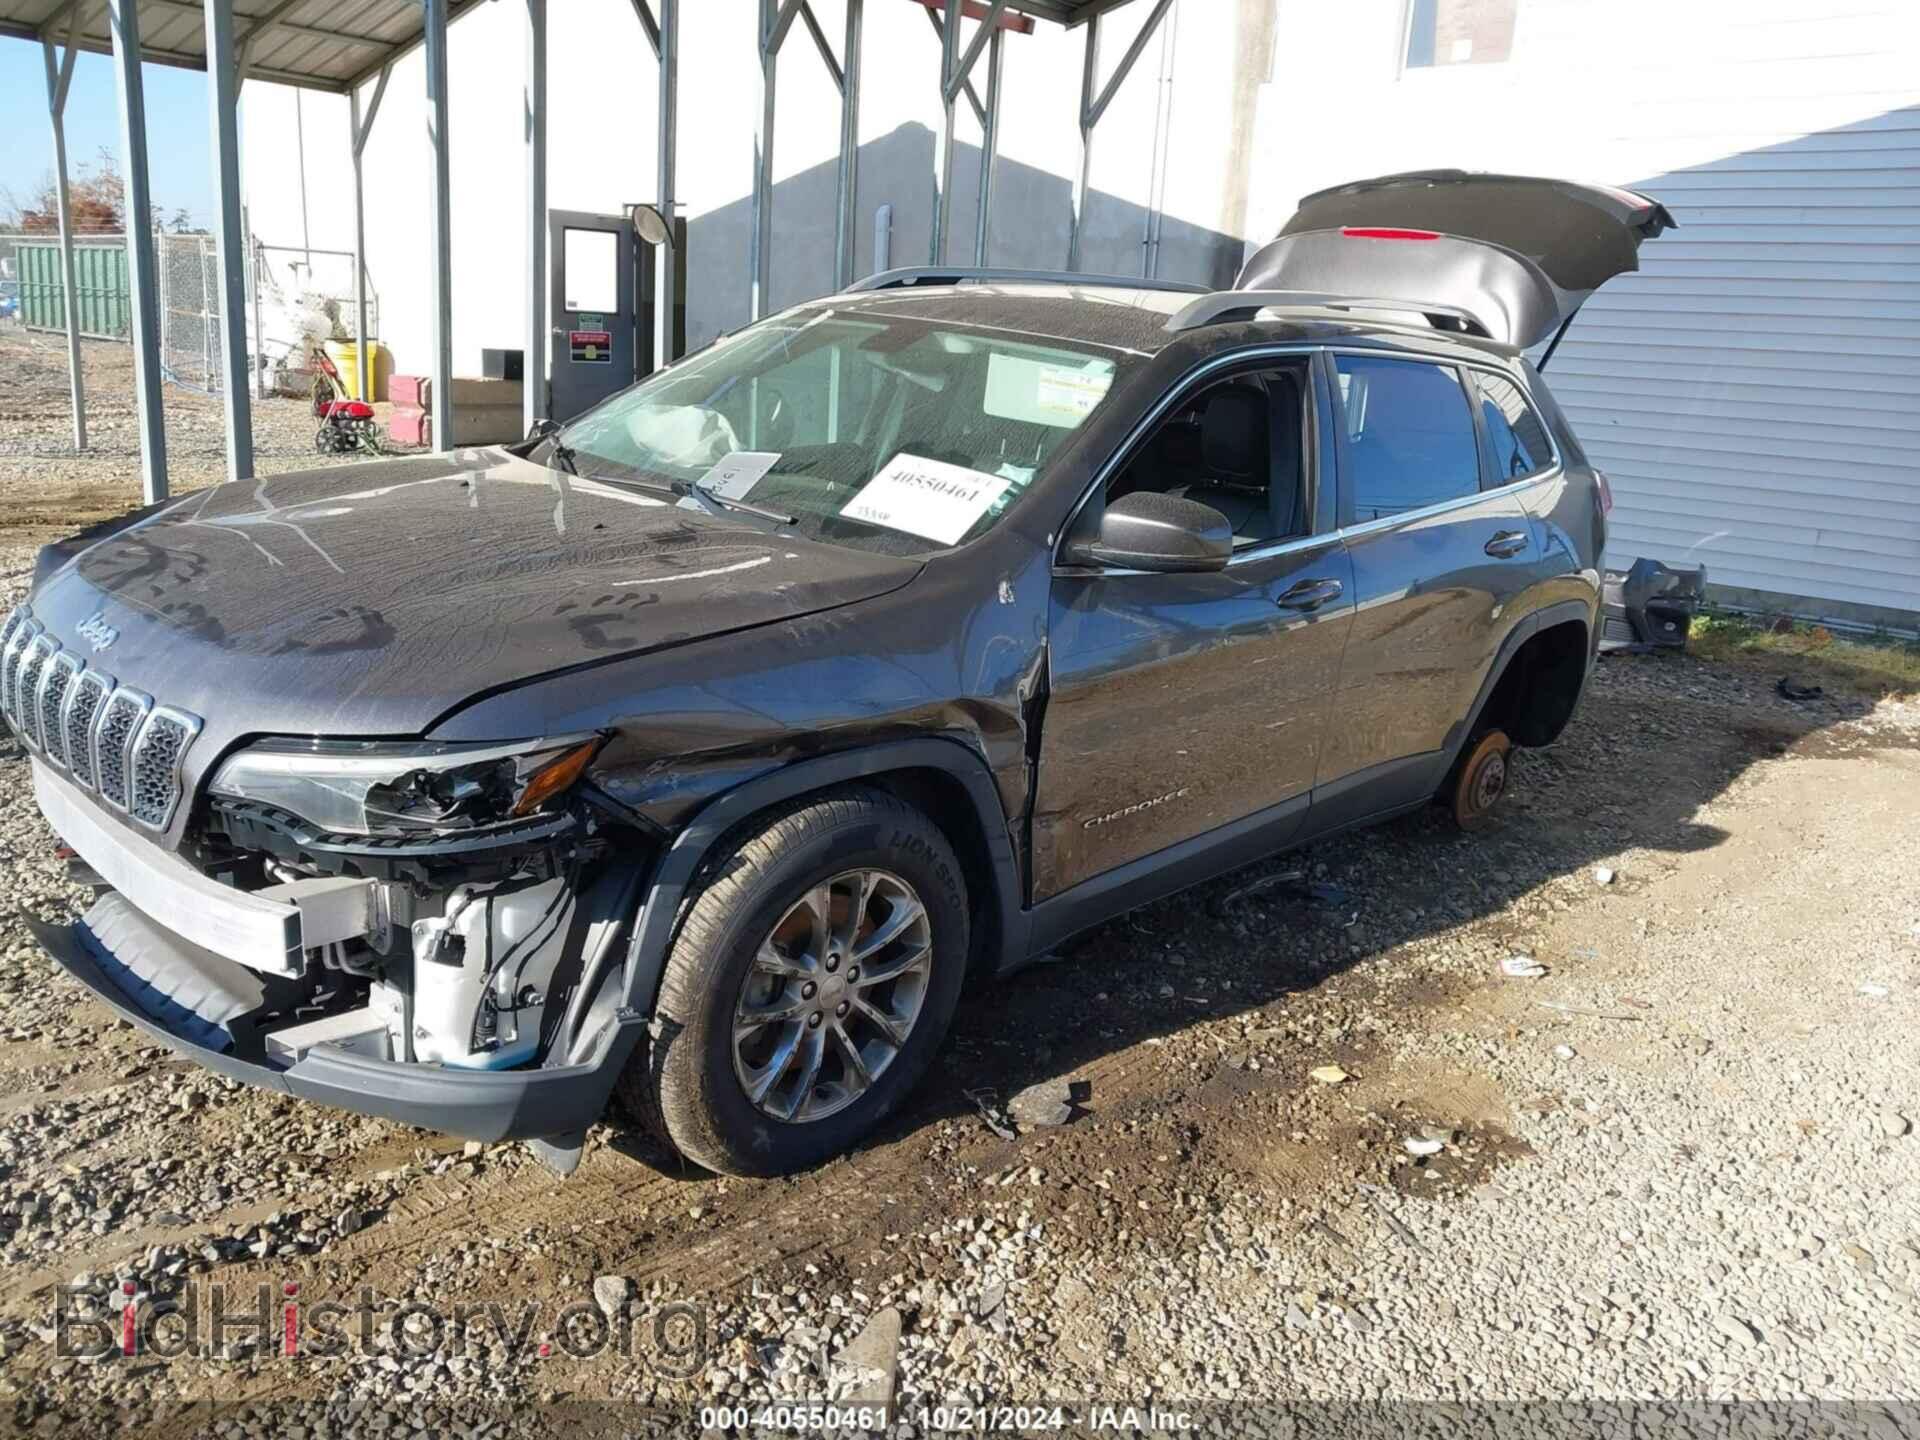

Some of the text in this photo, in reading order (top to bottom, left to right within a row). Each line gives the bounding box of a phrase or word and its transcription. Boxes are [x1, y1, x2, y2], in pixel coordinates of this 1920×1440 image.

[889, 470, 982, 502] 40550461
[75, 611, 121, 653] Jeep
[1082, 787, 1191, 830] CHEROKEE
